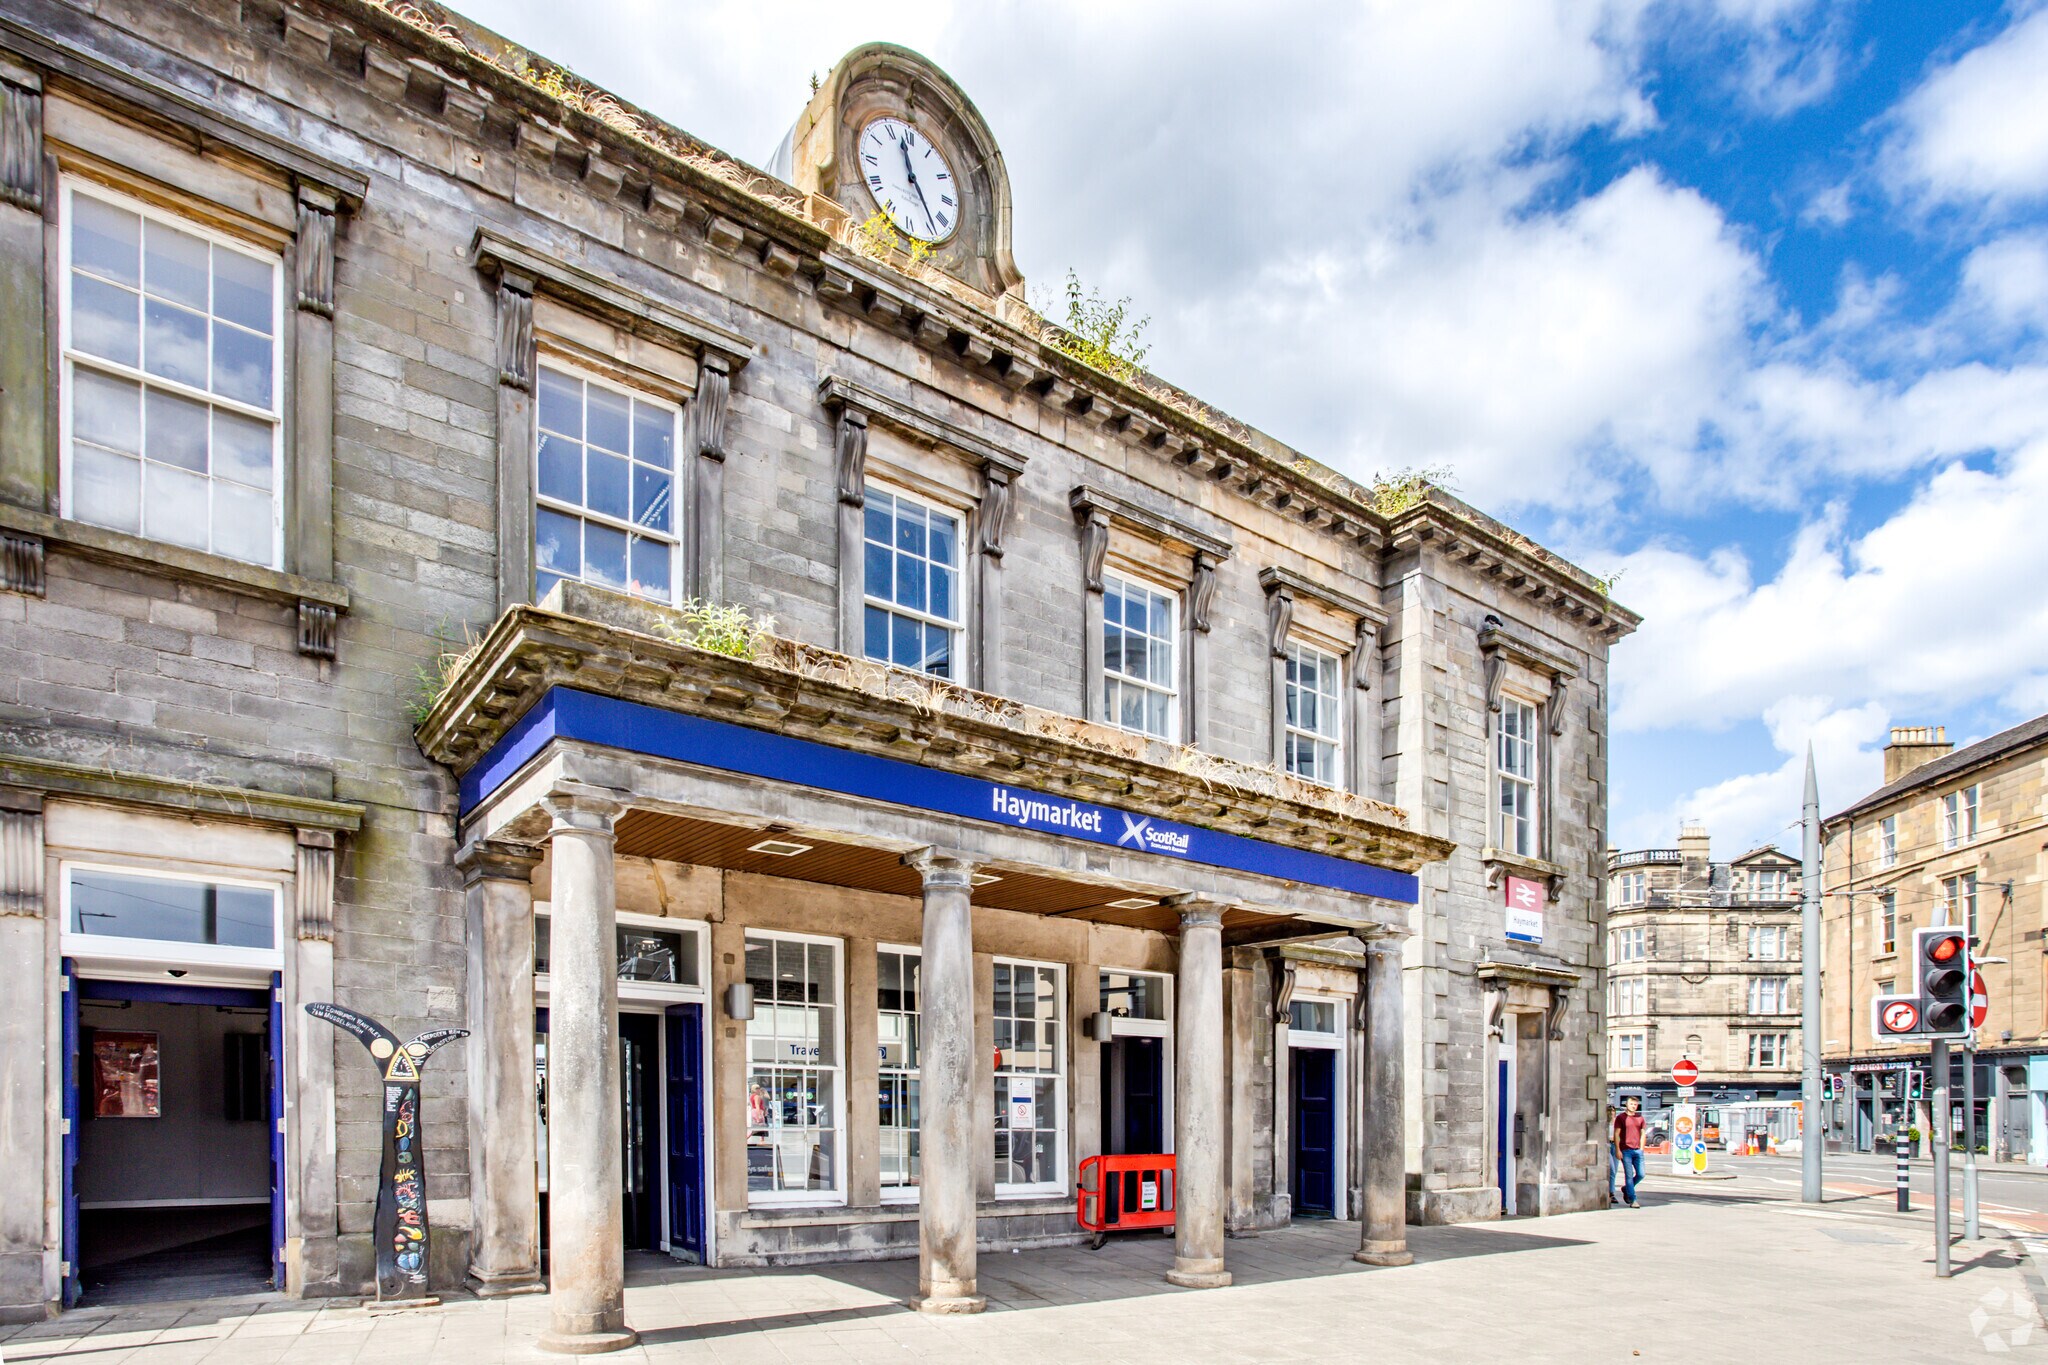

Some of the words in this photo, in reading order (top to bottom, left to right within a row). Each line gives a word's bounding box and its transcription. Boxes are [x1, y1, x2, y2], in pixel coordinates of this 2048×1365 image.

[992, 787, 1102, 833] Haymarket
[1145, 827, 1190, 848] ScotRail
[1513, 915, 1538, 928] Haymarket
[790, 1044, 819, 1056] Trave
